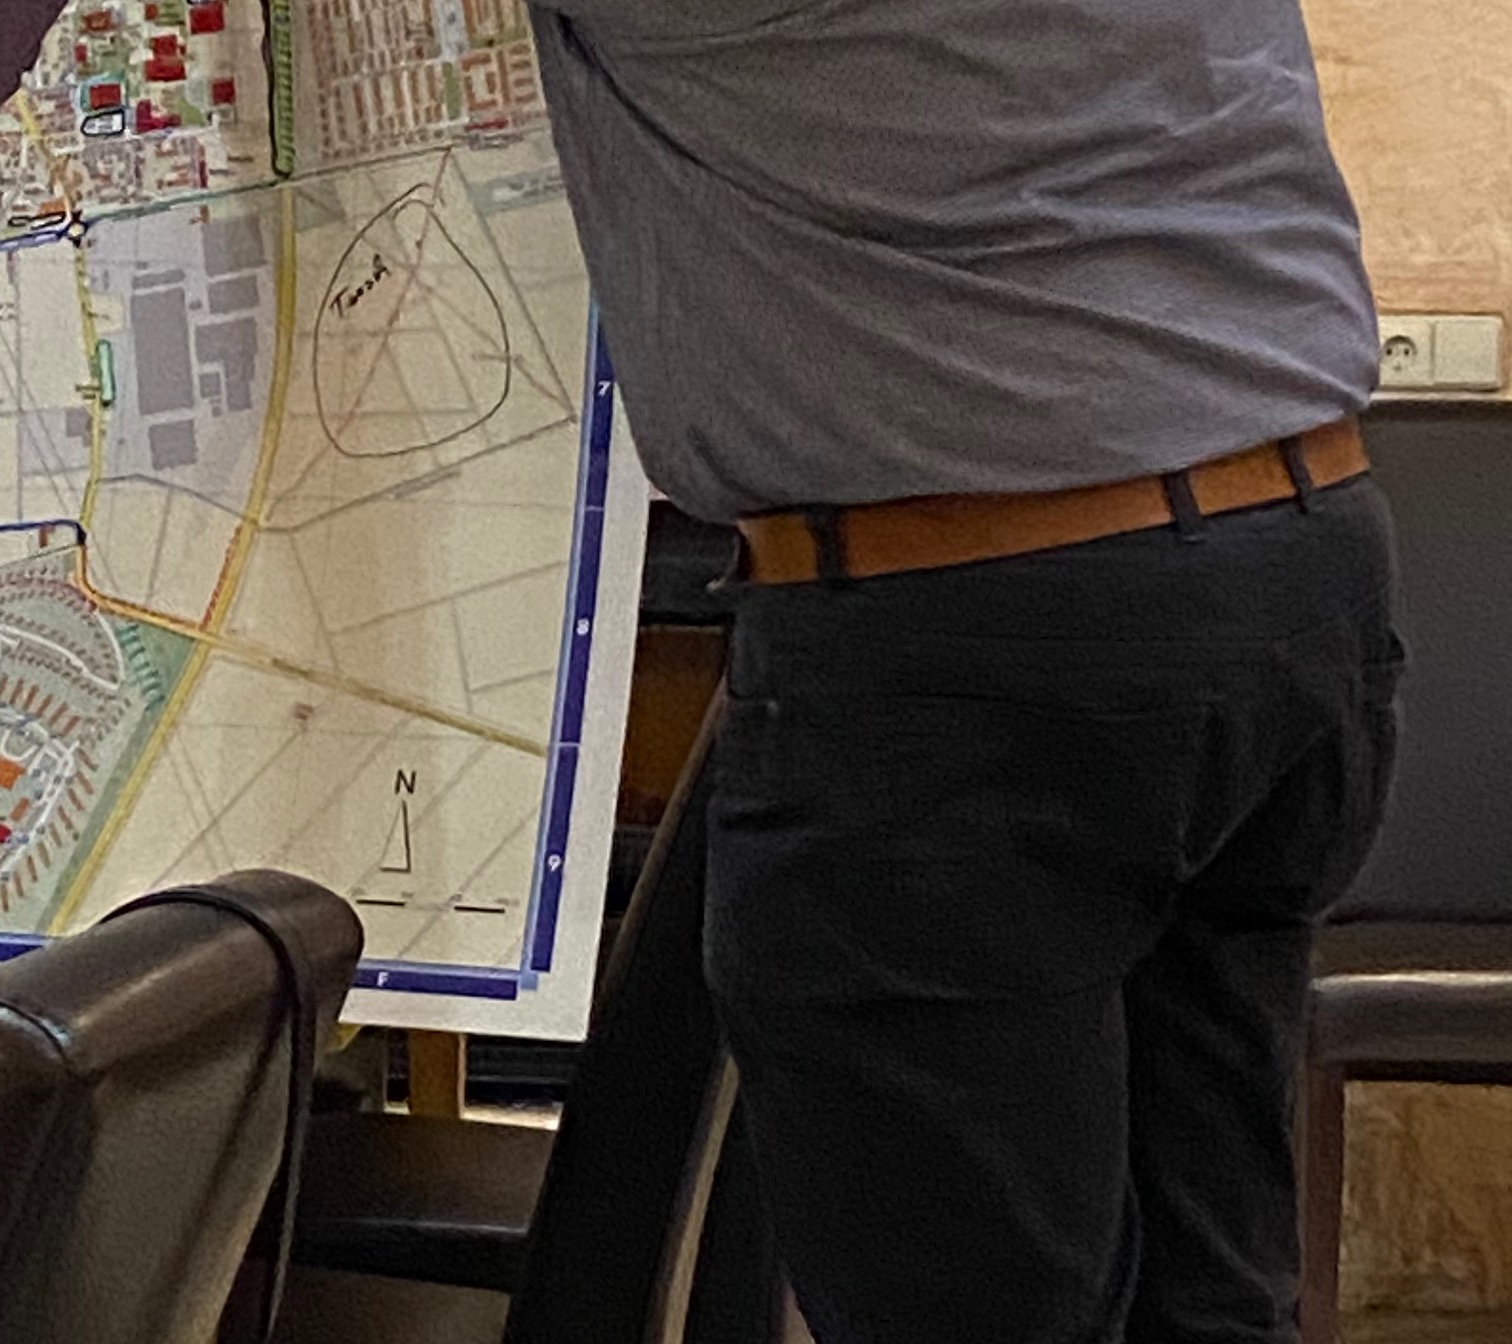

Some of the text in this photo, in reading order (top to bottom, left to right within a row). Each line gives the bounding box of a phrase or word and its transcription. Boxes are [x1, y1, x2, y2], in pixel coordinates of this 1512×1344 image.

[598, 380, 611, 397] 7
[576, 618, 589, 636] 8
[394, 768, 417, 795] N
[548, 854, 562, 873] 9
